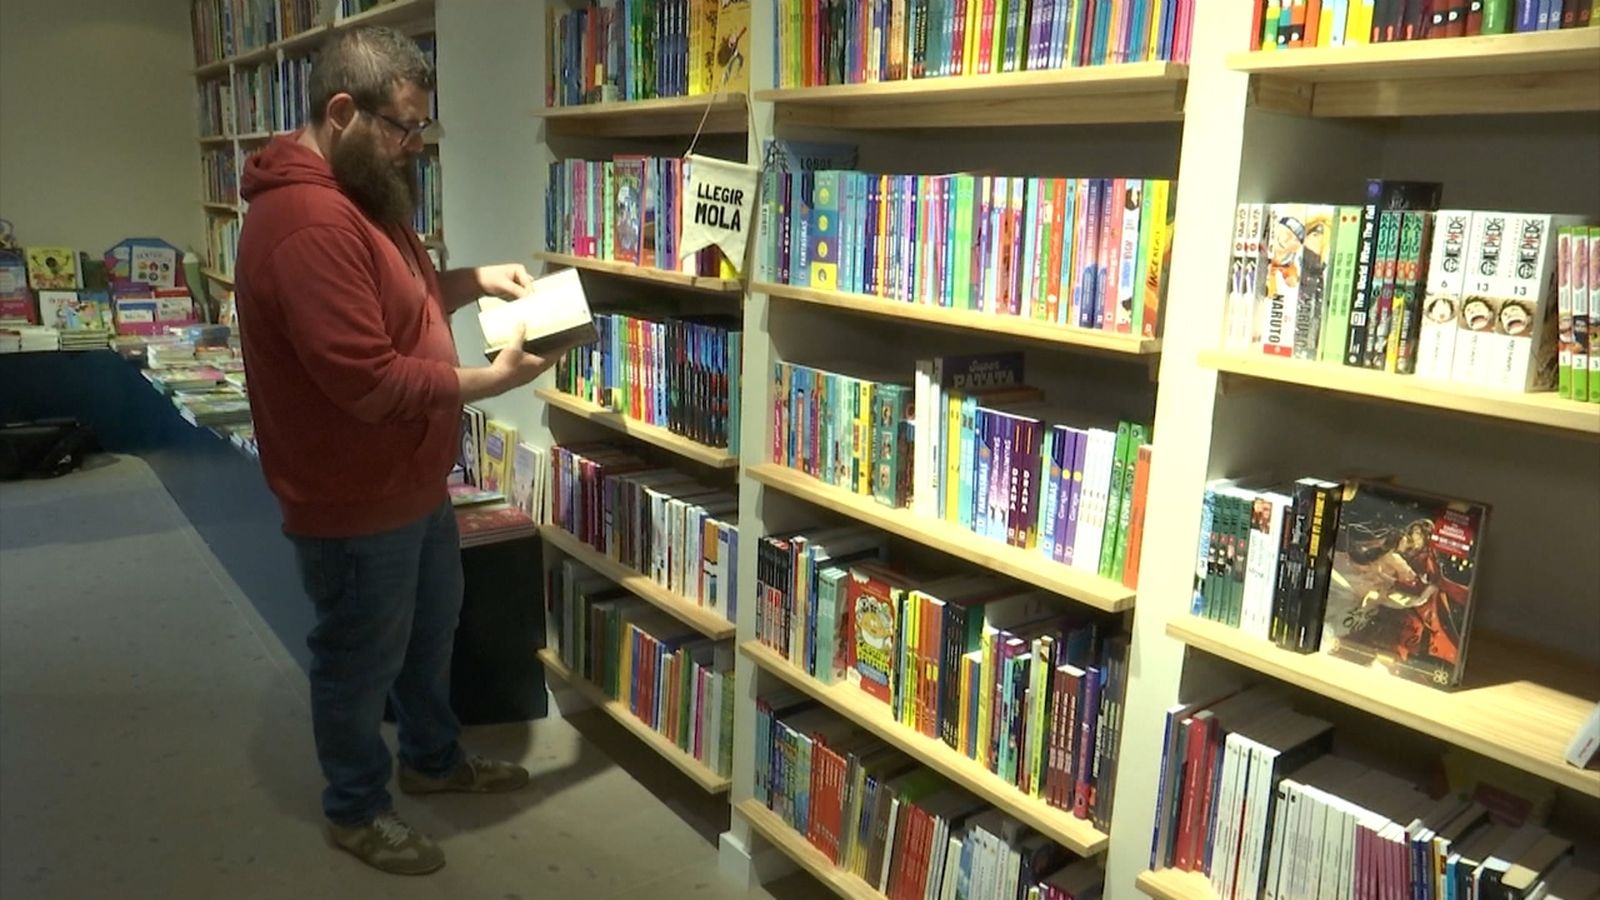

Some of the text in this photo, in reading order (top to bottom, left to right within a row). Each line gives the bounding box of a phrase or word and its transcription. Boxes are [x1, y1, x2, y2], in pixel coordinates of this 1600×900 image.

[695, 203, 741, 232] MOLA
[697, 183, 743, 206] LLEGIR
[800, 219, 808, 267] FANTASMAS
[1355, 204, 1377, 308] The World After The Fall
[1443, 216, 1466, 273] ONE PIECE
[1480, 217, 1505, 276] ONE PIECE
[1518, 219, 1544, 280] ONE PIECE
[1476, 282, 1489, 292] 13
[1513, 285, 1527, 296] 13
[1267, 294, 1286, 343] NARUTO
[953, 369, 1015, 389] PATATA
[969, 361, 999, 376] Super
[977, 462, 988, 515] FANTASMAS
[1010, 467, 1019, 511] DRAMA
[1020, 469, 1030, 514] DRAMA
[1045, 481, 1059, 535] FANTASMAS
